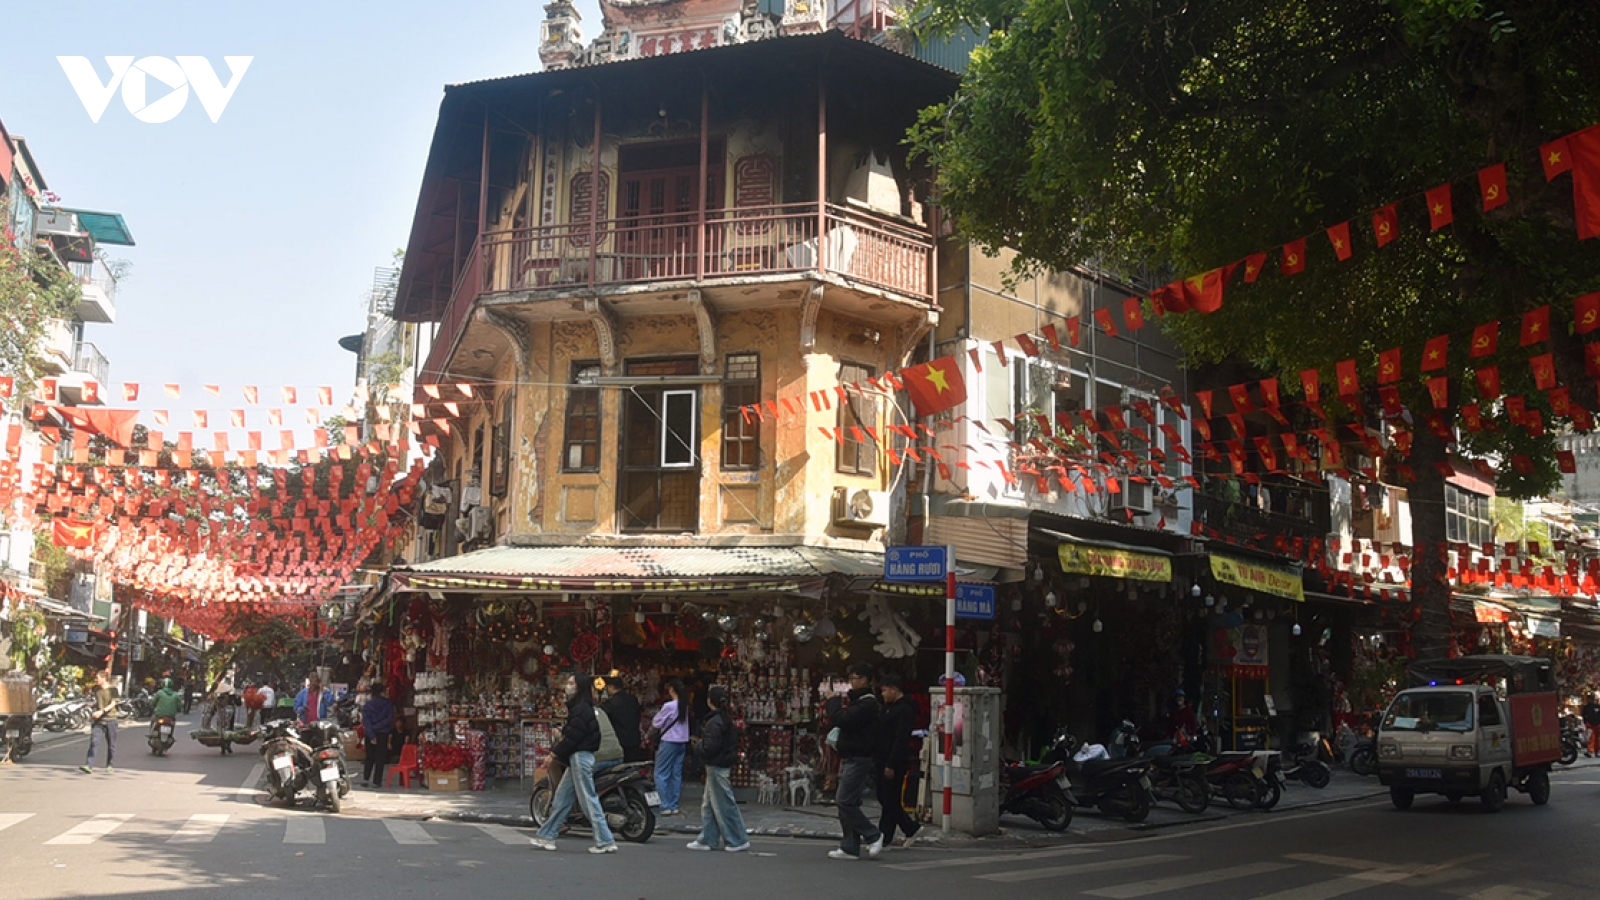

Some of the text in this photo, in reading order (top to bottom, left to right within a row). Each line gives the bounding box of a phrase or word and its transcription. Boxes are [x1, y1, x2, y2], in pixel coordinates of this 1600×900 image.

[909, 550, 929, 559] PHỐ
[889, 560, 941, 575] HÀNG RƯƠI
[1268, 571, 1291, 590] Decor
[956, 597, 978, 613] HÀNG
